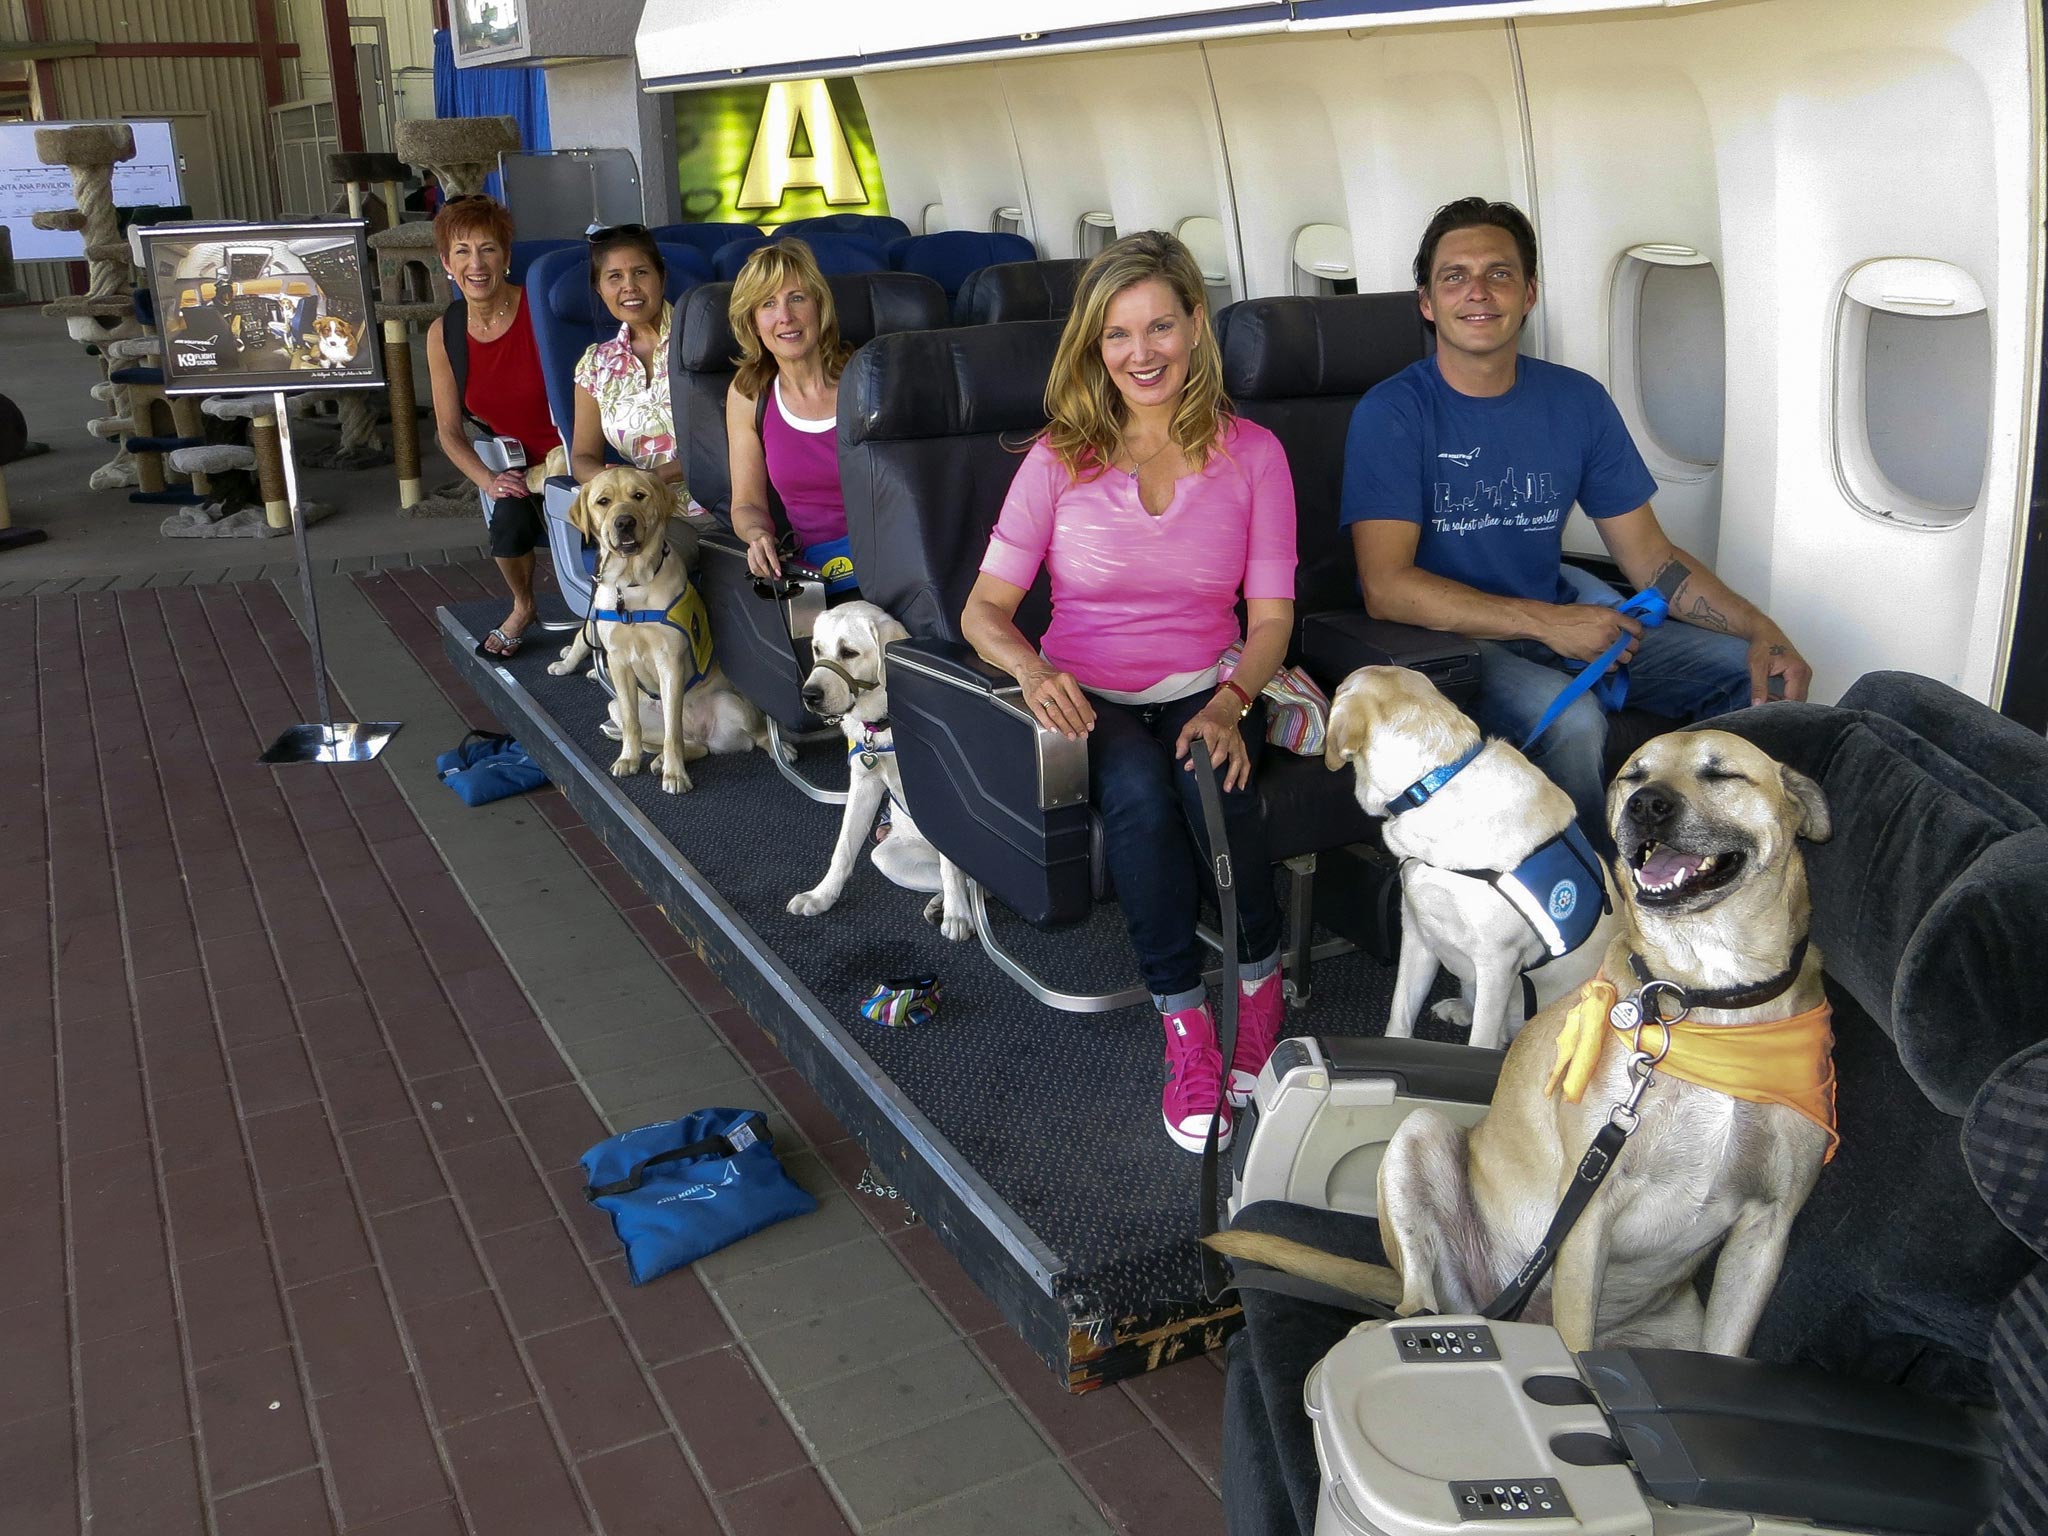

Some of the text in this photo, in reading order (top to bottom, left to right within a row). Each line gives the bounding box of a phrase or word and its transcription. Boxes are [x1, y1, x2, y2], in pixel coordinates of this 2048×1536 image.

[735, 78, 869, 210] A
[19, 182, 35, 190] ANA
[36, 181, 71, 189] PAVILION
[177, 352, 196, 367] K9
[1432, 518, 1449, 532] The
[1452, 518, 1477, 536] safest
[1502, 517, 1514, 526] in
[1514, 512, 1530, 526] the
[1531, 509, 1559, 525] world!
